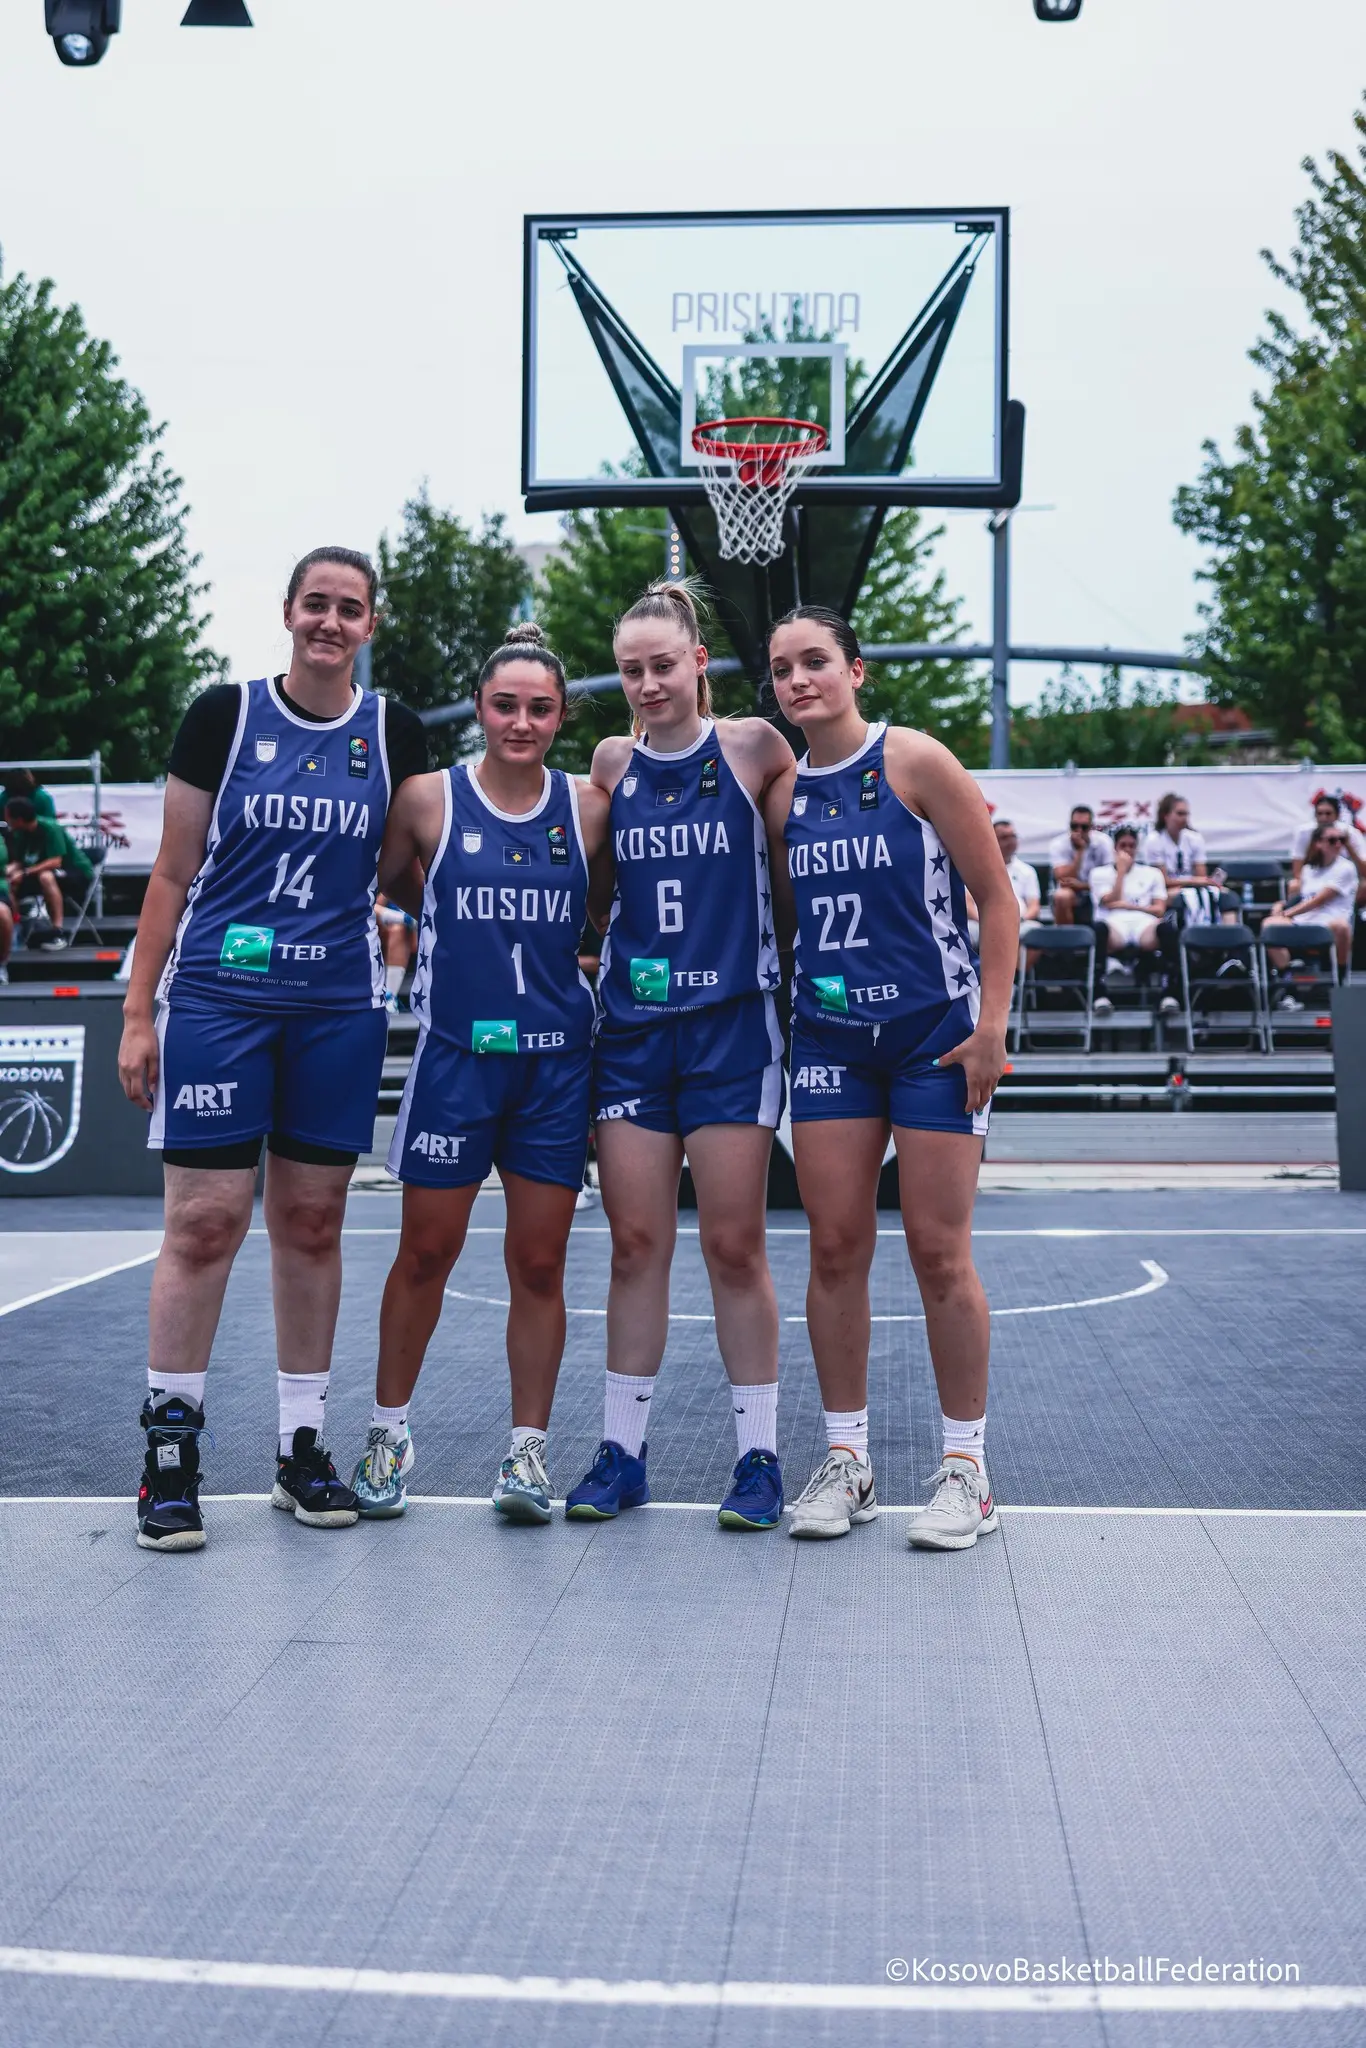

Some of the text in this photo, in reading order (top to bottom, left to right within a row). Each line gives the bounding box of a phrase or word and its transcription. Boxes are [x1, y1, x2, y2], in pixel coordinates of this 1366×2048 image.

[672, 292, 860, 332] PRISHTINA
[351, 759, 367, 769] FIBA
[702, 779, 716, 788] FIBA
[244, 794, 369, 839] KOSOVA
[552, 847, 567, 856] FIBA
[616, 821, 731, 861] KOSOVA
[788, 834, 893, 879] KOSOVA
[267, 852, 316, 909] 14
[456, 886, 572, 923] KOSOVA
[657, 879, 683, 933] 6
[811, 893, 869, 952] 22
[277, 943, 327, 961] TEB
[217, 970, 309, 987] BNP PARIBAS JOINT VENTURE
[511, 943, 526, 995] 1
[674, 970, 719, 987] TEB
[850, 983, 900, 1003] TEB
[523, 1031, 565, 1049] TEB
[793, 1065, 847, 1089] ART
[173, 1082, 238, 1110] ART
[196, 1108, 233, 1118] MOTION
[409, 1131, 467, 1158] ART
[428, 1156, 459, 1165] MOTION
